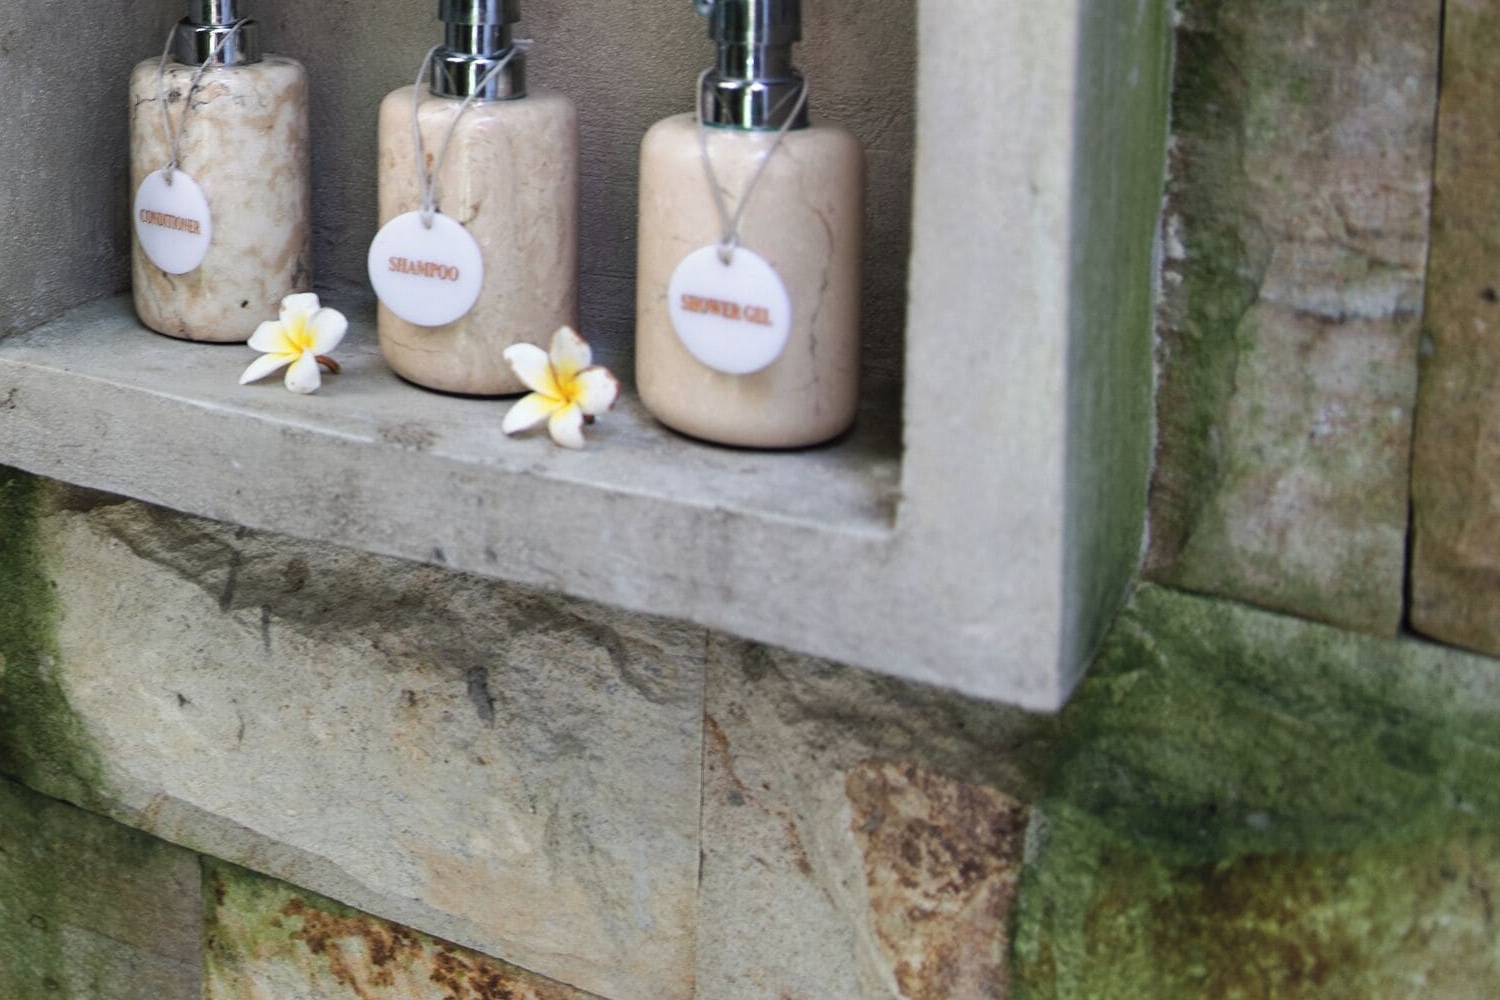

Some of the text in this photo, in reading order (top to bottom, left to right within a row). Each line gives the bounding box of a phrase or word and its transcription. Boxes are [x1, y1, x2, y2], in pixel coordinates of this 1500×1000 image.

[140, 209, 202, 234] CONDITIONER
[388, 256, 460, 281] SHAMPOO
[681, 294, 773, 327] SHOWER GEL
